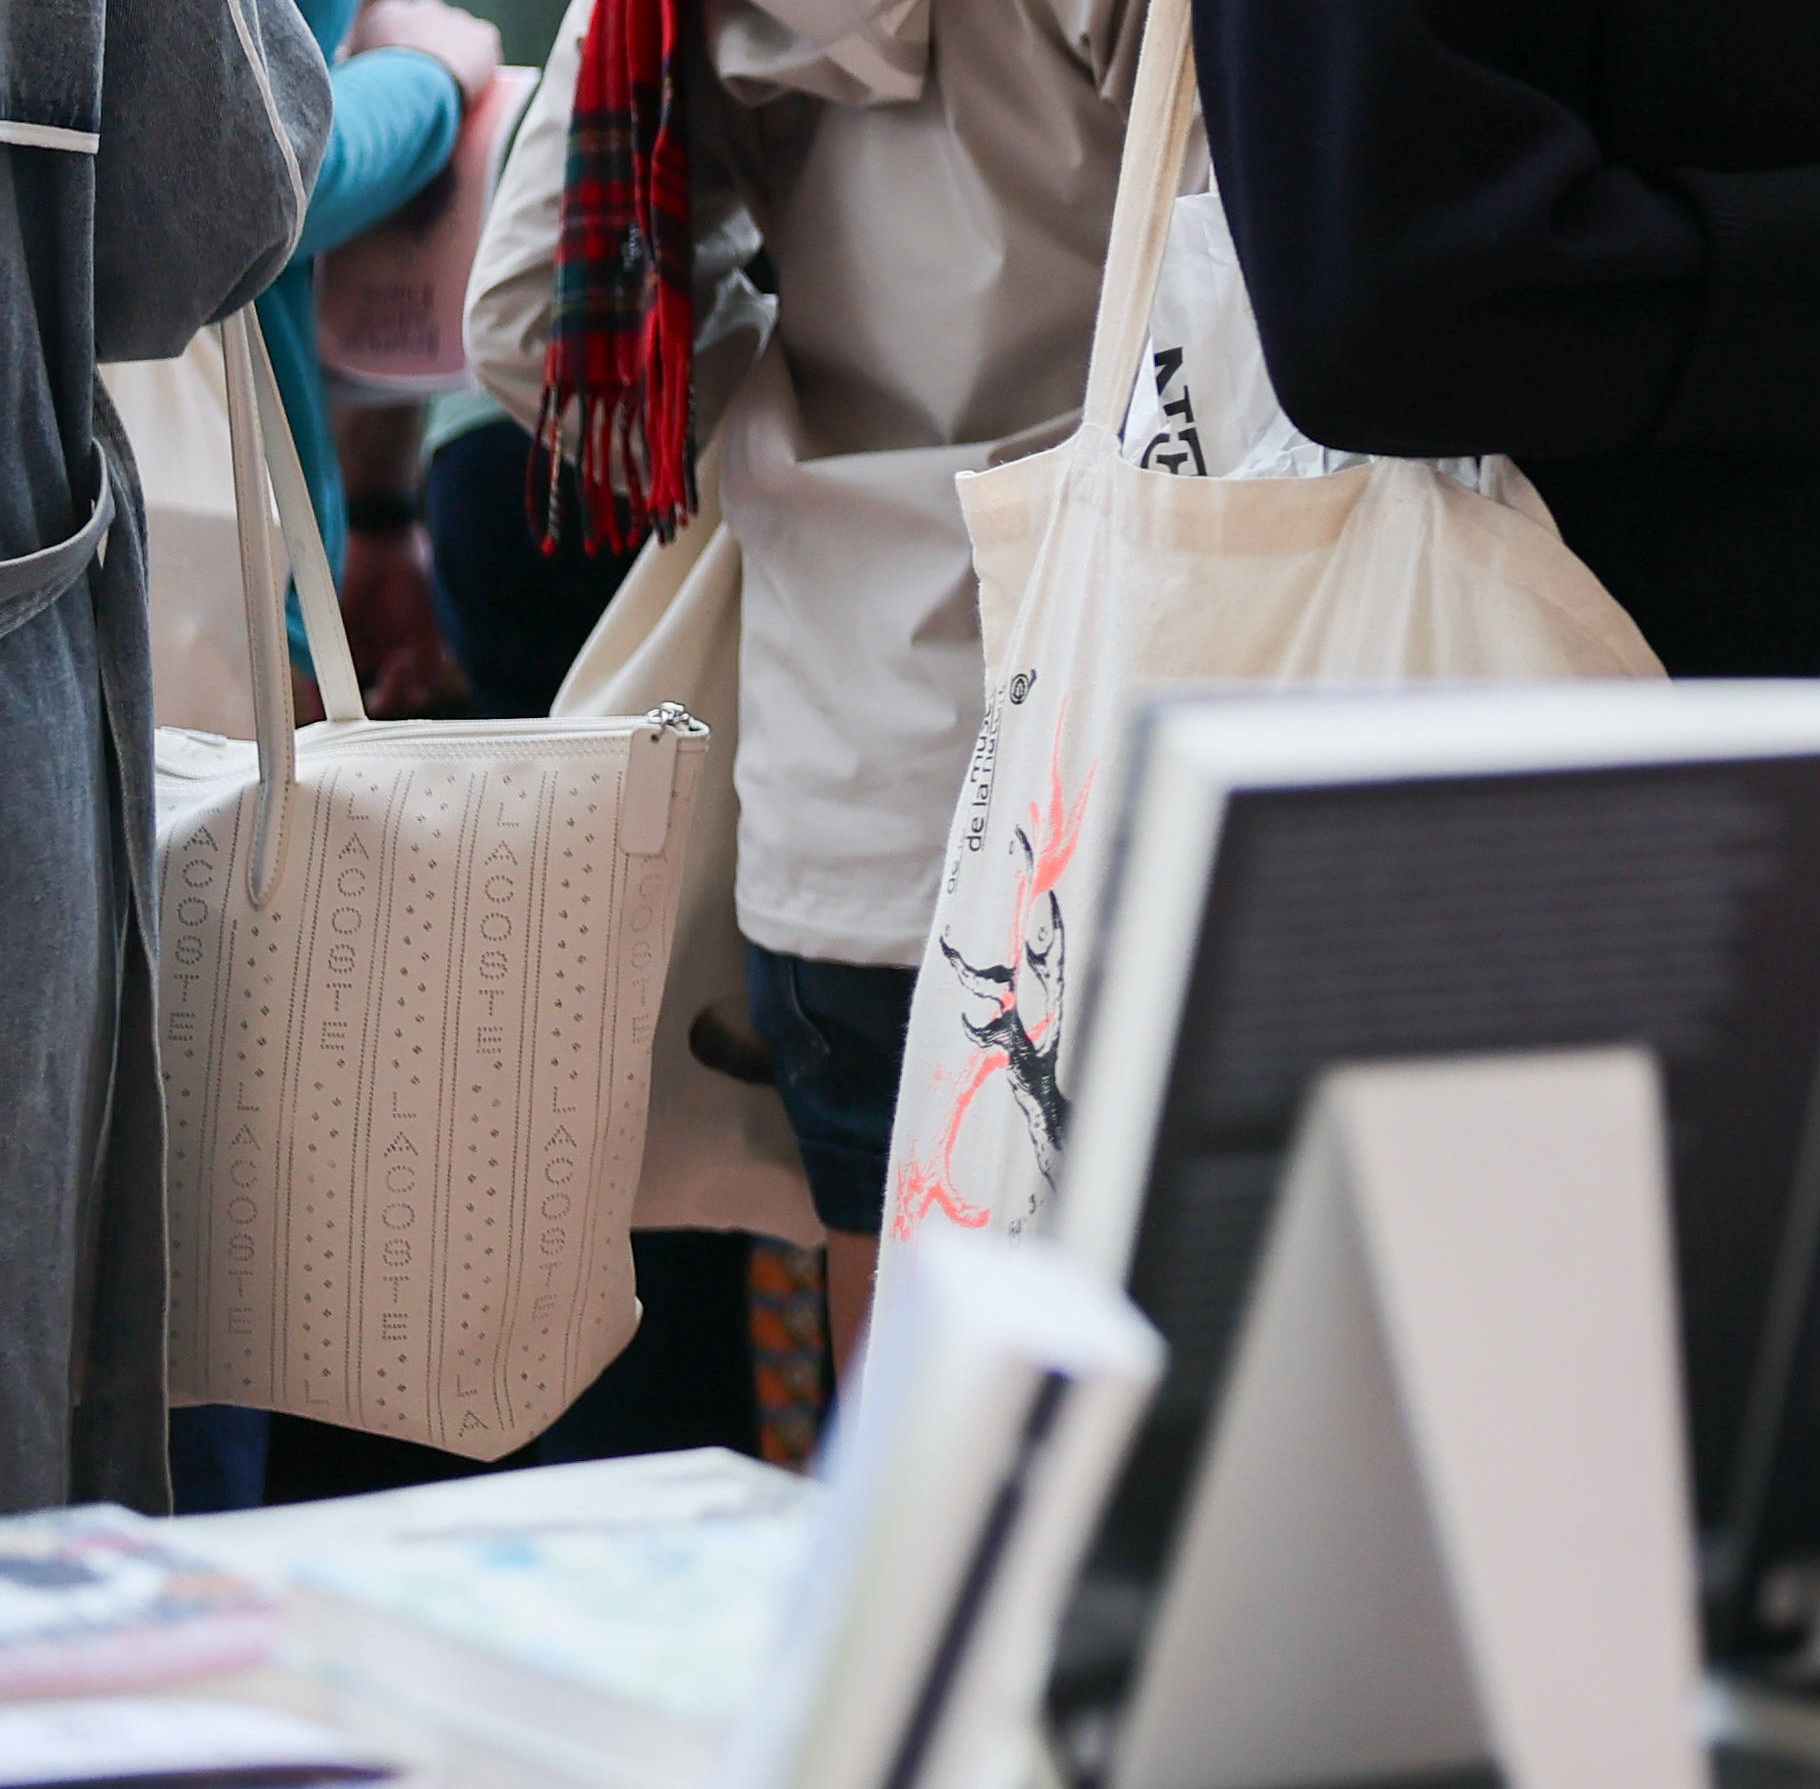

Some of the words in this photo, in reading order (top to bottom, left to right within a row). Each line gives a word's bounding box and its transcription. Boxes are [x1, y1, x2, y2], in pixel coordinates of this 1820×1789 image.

[966, 818, 984, 851] de
[972, 784, 989, 806] la
[320, 793, 370, 1051] LACOSTE
[476, 801, 520, 1055] LACOSTE
[227, 1080, 261, 1334] LACOSTE
[382, 1090, 419, 1341] LACOSTE
[532, 1086, 578, 1320] LACOSTE
